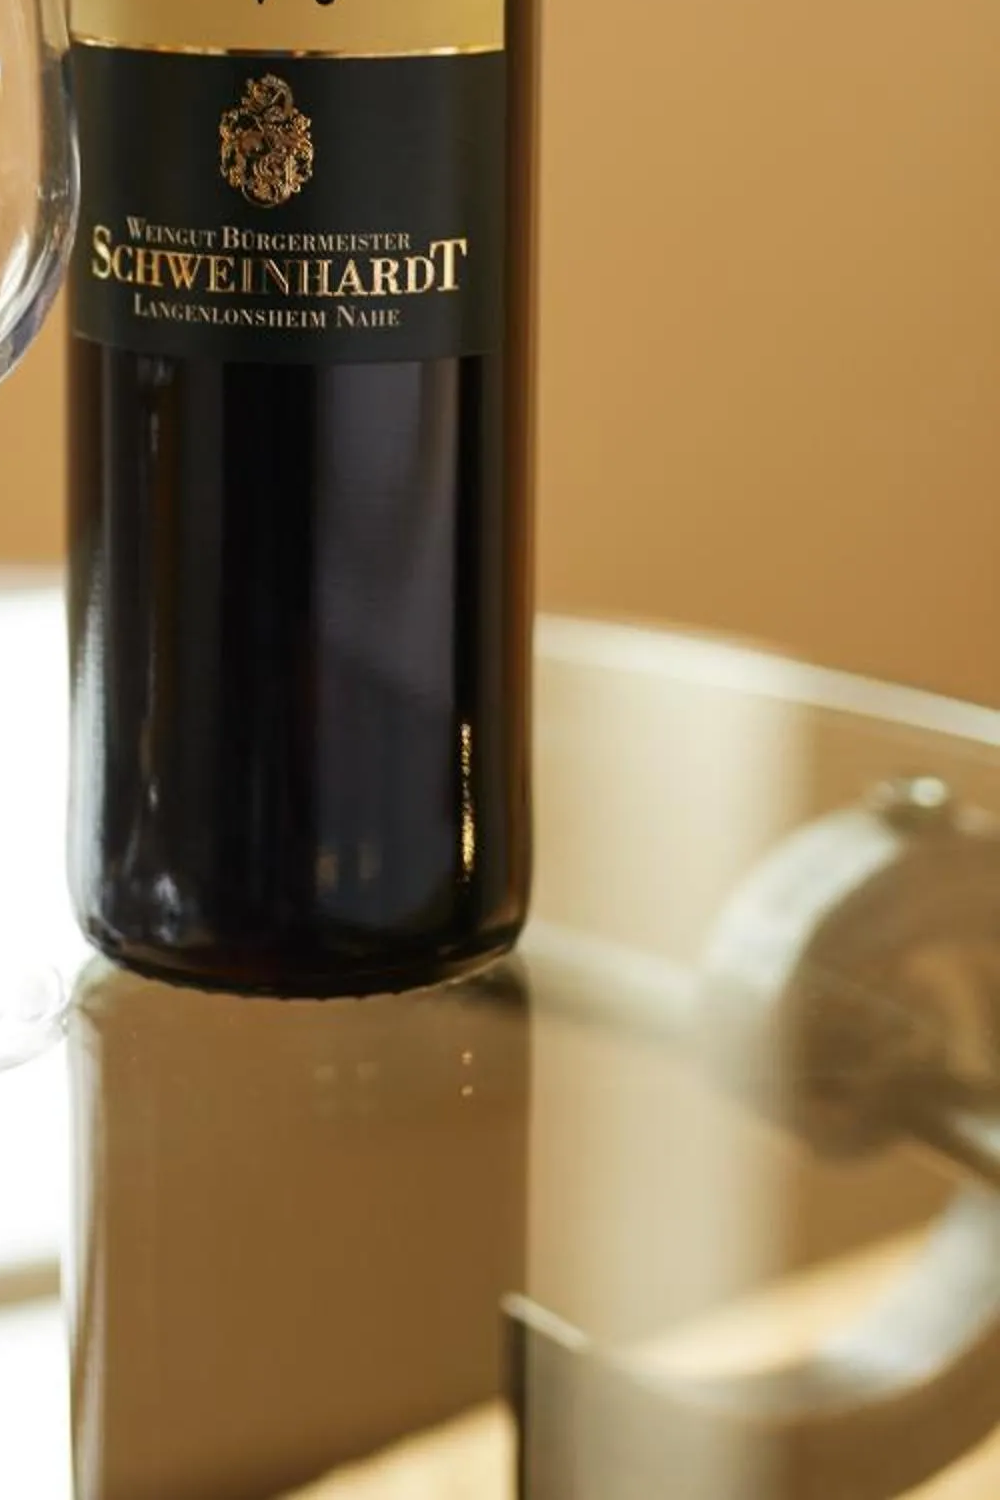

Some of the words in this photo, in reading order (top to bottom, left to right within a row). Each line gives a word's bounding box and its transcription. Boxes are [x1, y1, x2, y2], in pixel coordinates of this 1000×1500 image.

[126, 215, 217, 249] WEINGUT
[221, 225, 412, 252] BÜRGERMEISTER
[91, 224, 468, 299] SCHWEINHARDT
[133, 292, 327, 329] LANGENLONSHEIM
[335, 304, 402, 328] NAHE
